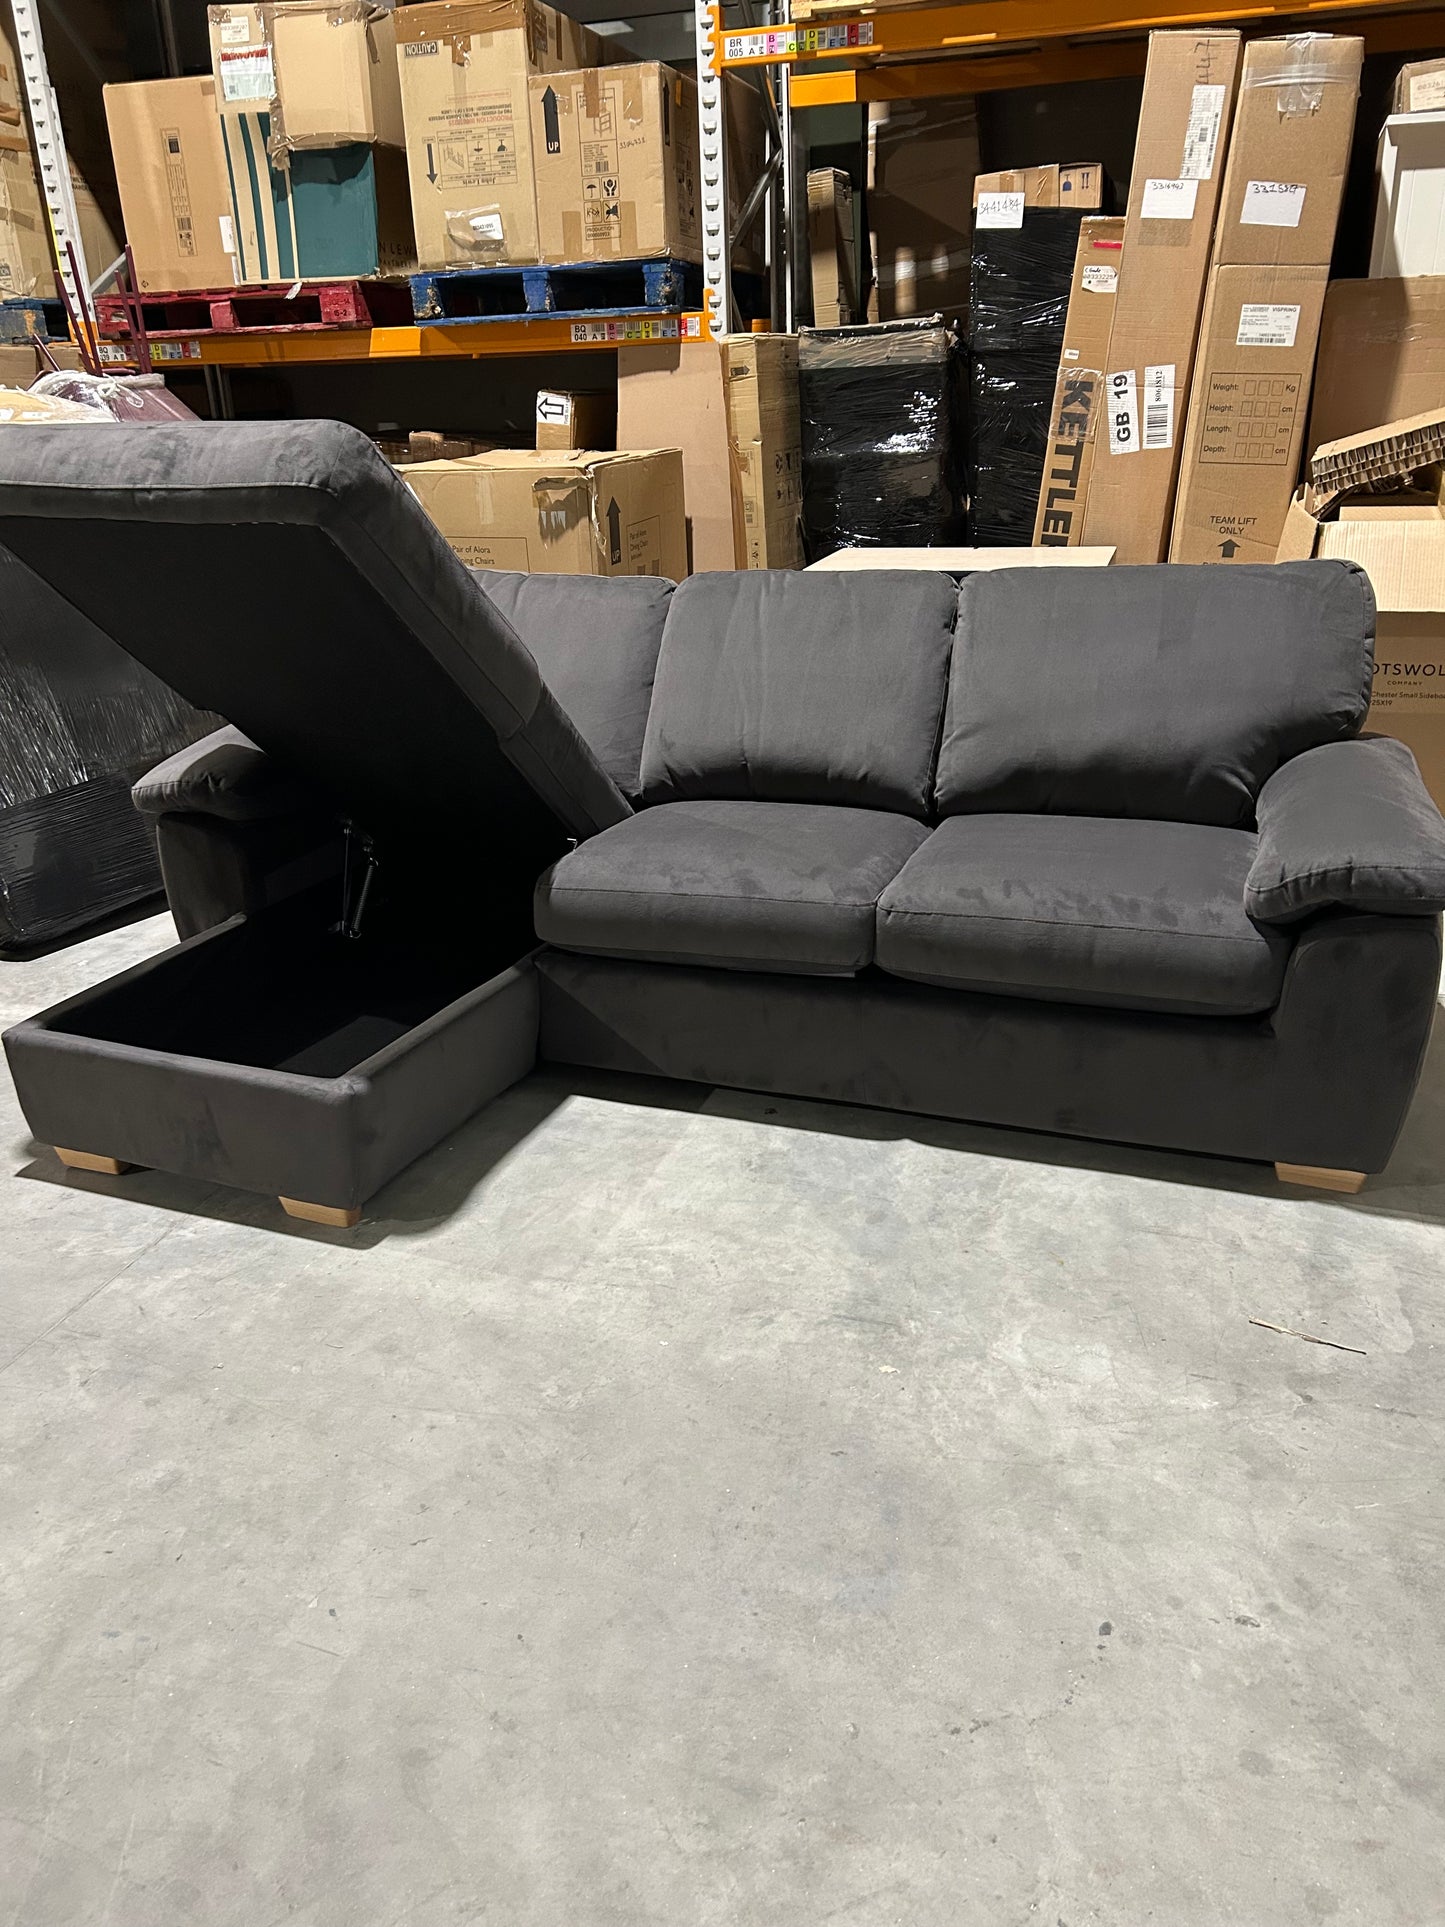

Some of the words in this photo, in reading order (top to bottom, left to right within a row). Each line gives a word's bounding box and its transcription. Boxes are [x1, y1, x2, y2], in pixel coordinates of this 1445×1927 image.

[768, 34, 775, 42] B
[730, 38, 742, 48] BR
[788, 43, 795, 51] C
[406, 42, 436, 54] CAUTION
[729, 48, 744, 57] 005
[548, 142, 559, 151] UP
[390, 244, 413, 255] LEW
[1114, 374, 1128, 399] 19
[1213, 383, 1239, 391] Weight:
[1286, 384, 1296, 392] Kg
[1116, 411, 1131, 442] GB
[1210, 516, 1235, 524] TEAM
[1219, 526, 1244, 534] ONLY
[612, 549, 620, 562] UP
[1372, 663, 1445, 676] OTSWOL
